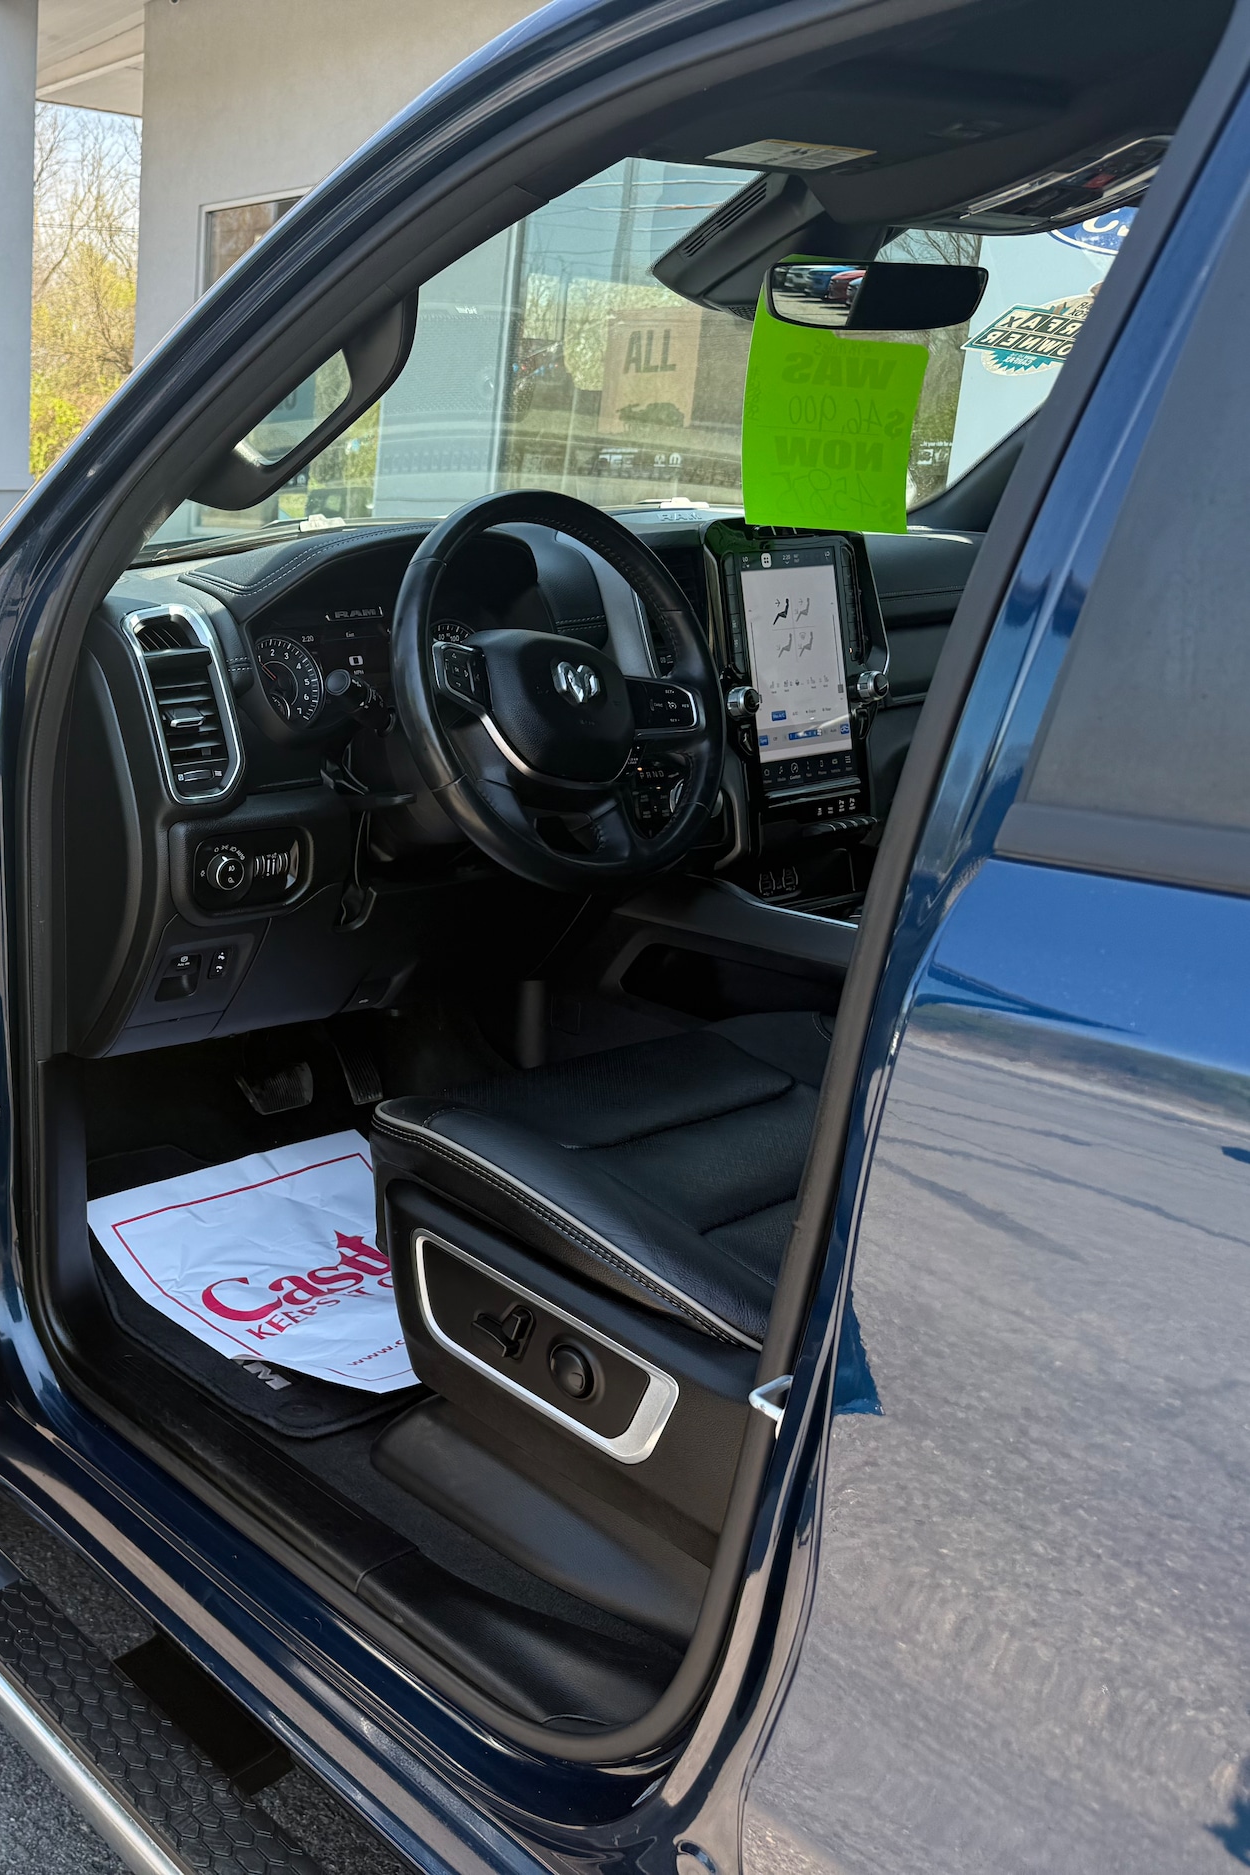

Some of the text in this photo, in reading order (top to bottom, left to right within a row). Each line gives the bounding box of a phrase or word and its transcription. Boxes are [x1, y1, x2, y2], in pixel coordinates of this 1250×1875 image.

[623, 328, 677, 374] ALL
[334, 608, 377, 619] RAM
[270, 649, 275, 657] 2
[284, 652, 290, 660] 3
[296, 662, 302, 670] 4
[304, 678, 310, 686] 5
[245, 1297, 341, 1340] KEEPS
